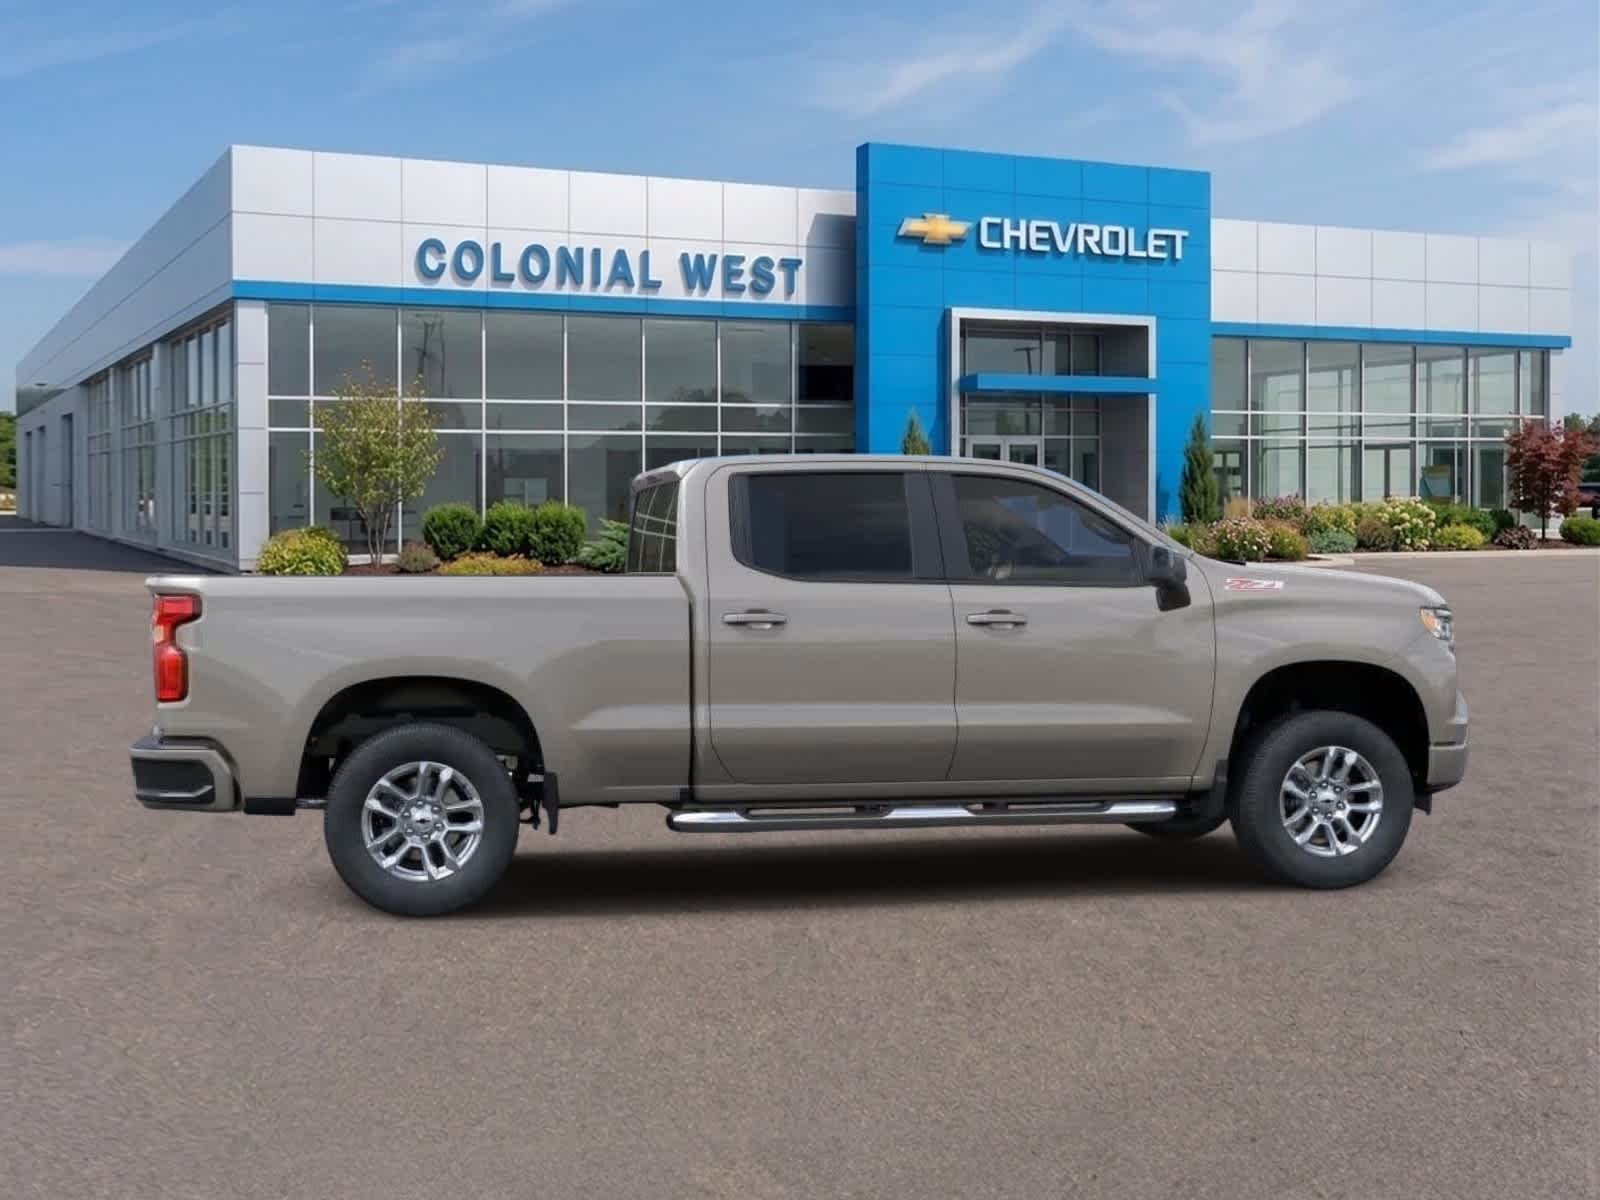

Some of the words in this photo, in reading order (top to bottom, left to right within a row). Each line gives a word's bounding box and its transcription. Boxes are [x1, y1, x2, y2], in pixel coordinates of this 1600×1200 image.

[980, 216, 1188, 259] CHEVROLET
[416, 238, 662, 289] COLONIAL
[679, 252, 802, 297] WEST
